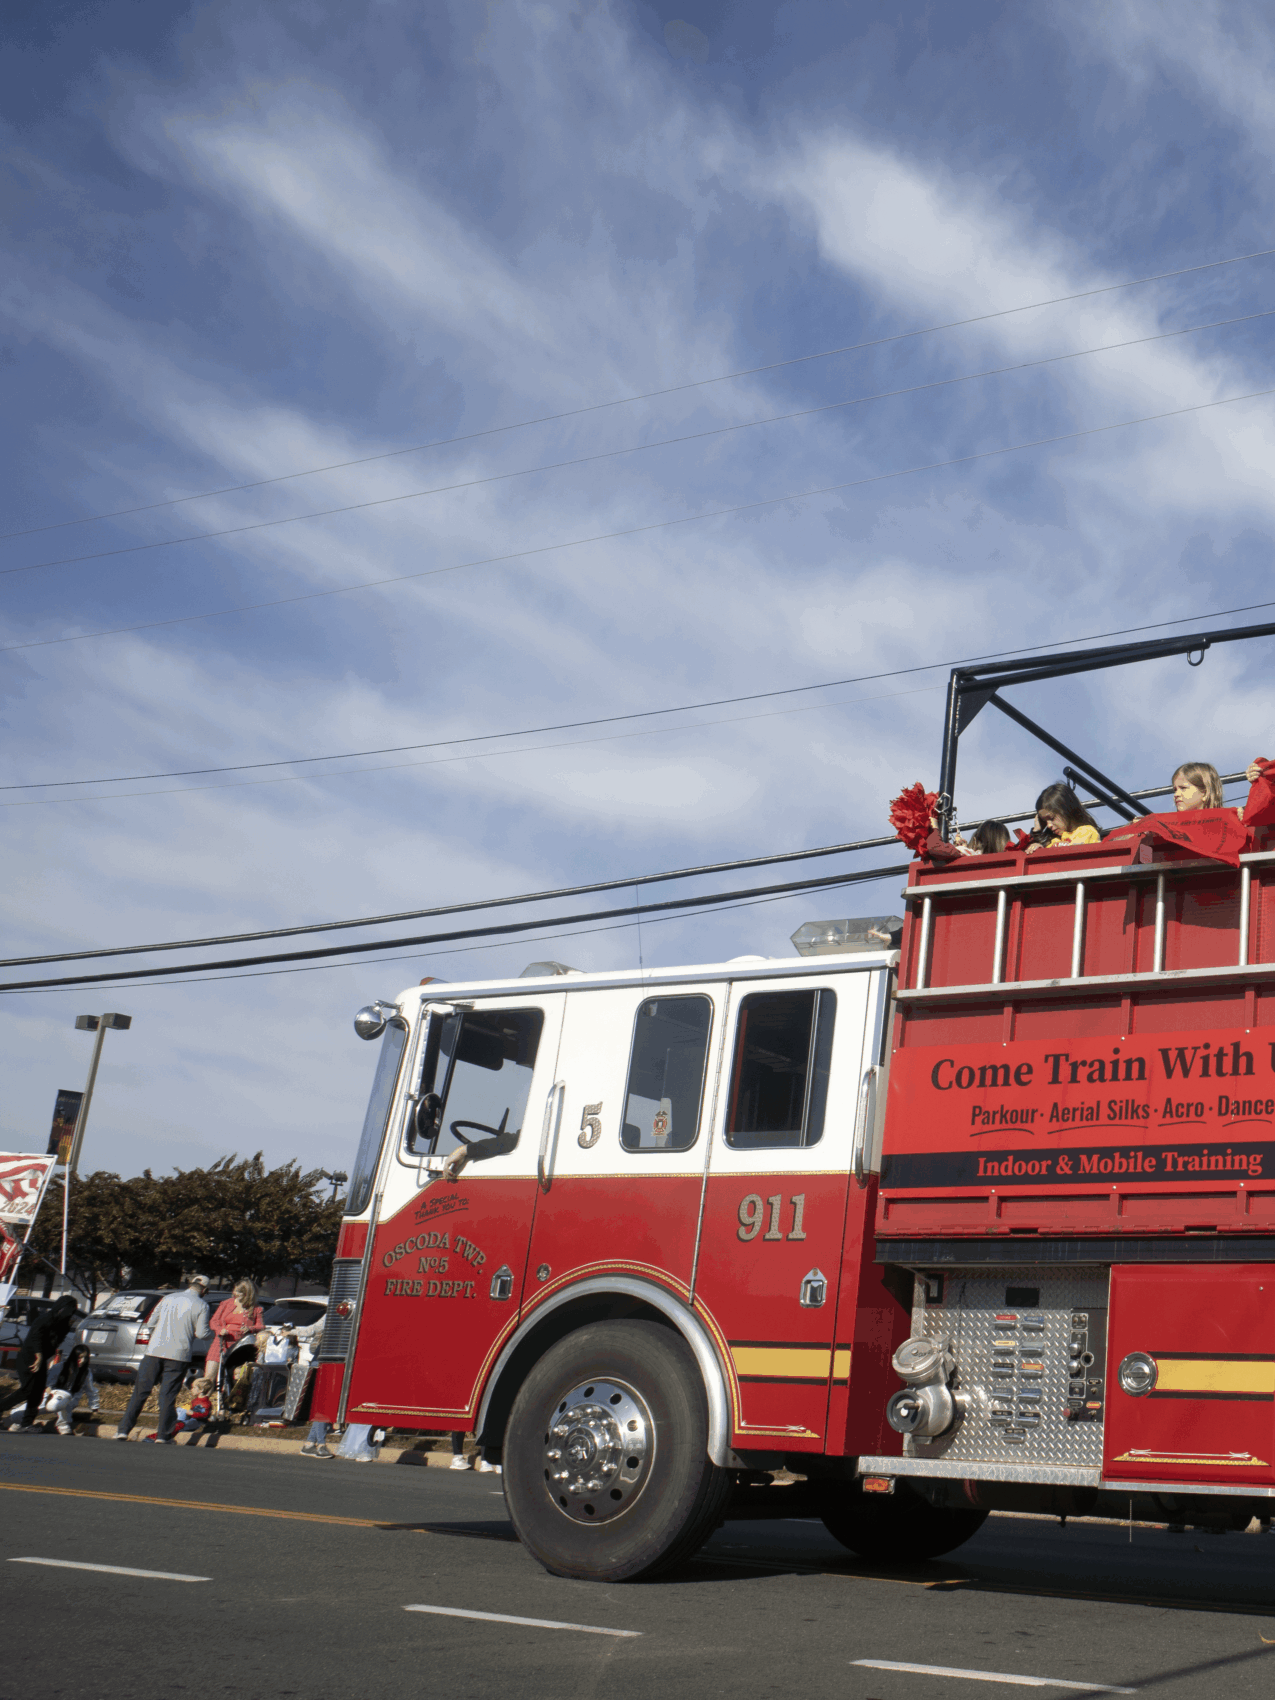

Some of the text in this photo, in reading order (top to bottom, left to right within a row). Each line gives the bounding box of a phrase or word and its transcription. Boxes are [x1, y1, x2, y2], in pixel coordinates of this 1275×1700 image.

[931, 1059, 1034, 1091] Come
[1044, 1047, 1148, 1085] Train
[1158, 1040, 1256, 1080] With
[577, 1101, 603, 1149] 5
[970, 1095, 1275, 1126] Parkour Aerial Silks Acro Dance
[976, 1148, 1264, 1177] Indoor & Mobile Training
[414, 1206, 440, 1220] THANK
[442, 1202, 456, 1212] YOU
[420, 1192, 460, 1210] A SPECIAL
[737, 1193, 806, 1242] 911
[383, 1231, 488, 1275] OSCODA TWP.
[384, 1278, 477, 1299] FIRE DEPT.
